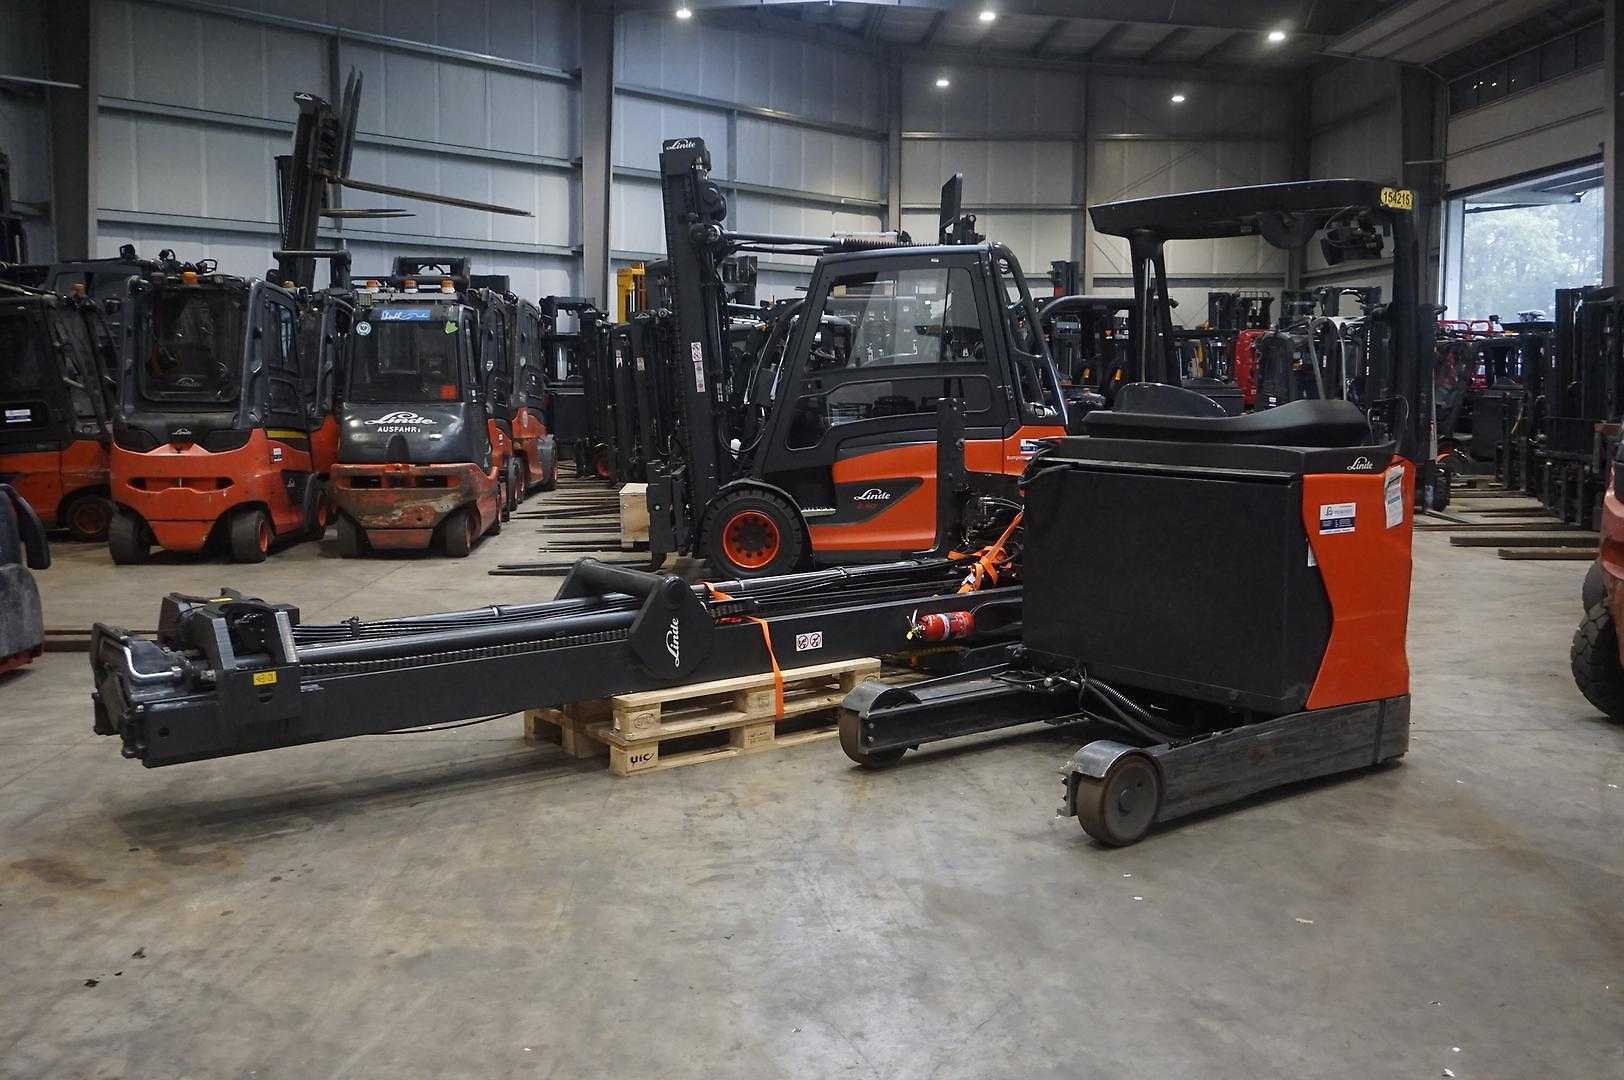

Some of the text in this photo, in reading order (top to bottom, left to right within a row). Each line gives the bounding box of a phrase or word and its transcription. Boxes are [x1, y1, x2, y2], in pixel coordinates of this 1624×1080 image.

[666, 138, 696, 151] Linde
[363, 411, 438, 424] Linde
[1346, 456, 1374, 470] Linde
[853, 488, 891, 501] Linde
[665, 617, 680, 668] Linde
